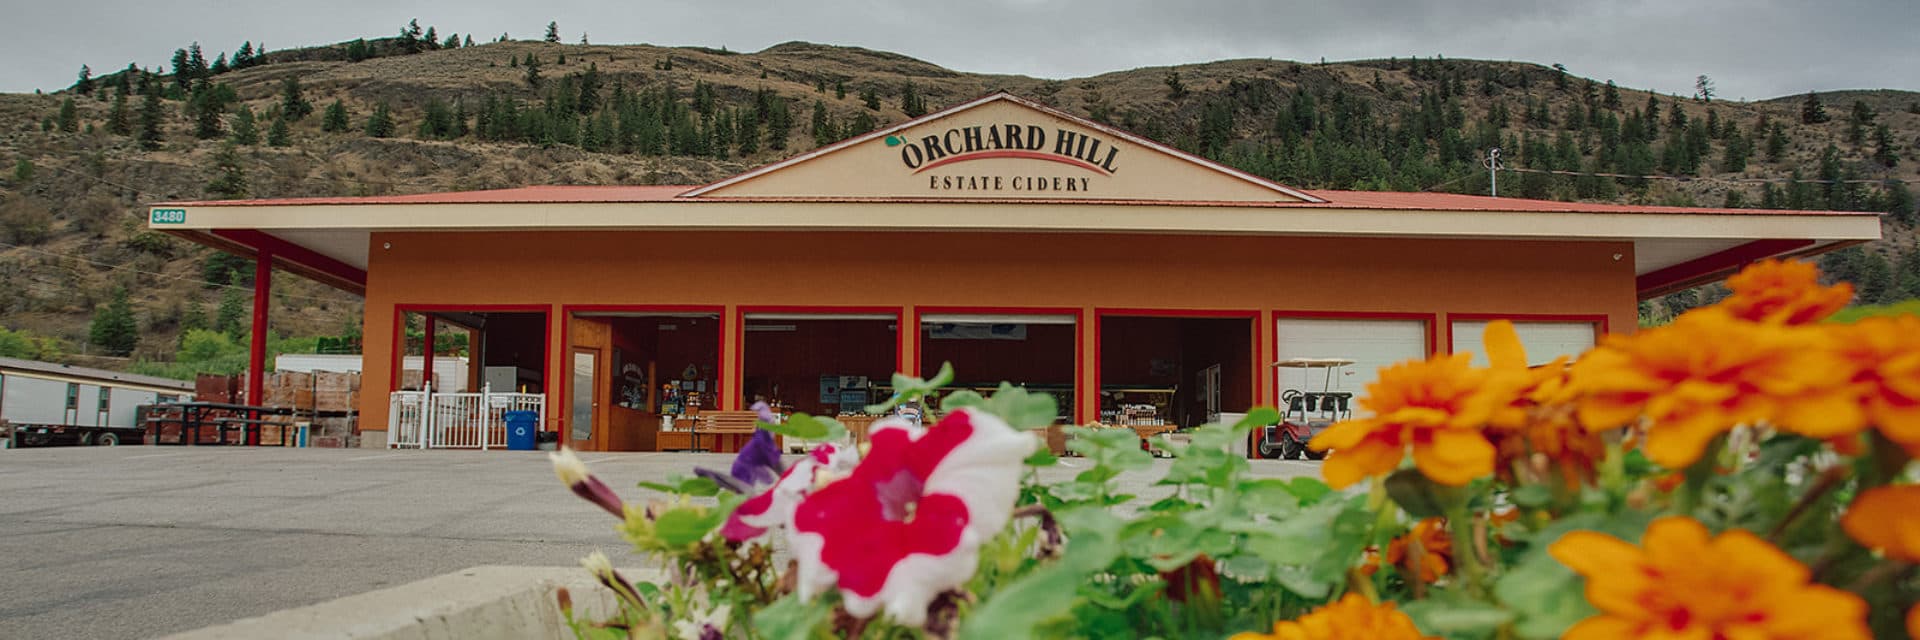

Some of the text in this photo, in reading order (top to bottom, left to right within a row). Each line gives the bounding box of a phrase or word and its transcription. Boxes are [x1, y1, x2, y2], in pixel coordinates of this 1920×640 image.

[902, 124, 1121, 174] ORCHARD HILL
[930, 175, 1091, 192] ESTATE CIDERY
[154, 211, 183, 222] 3480
